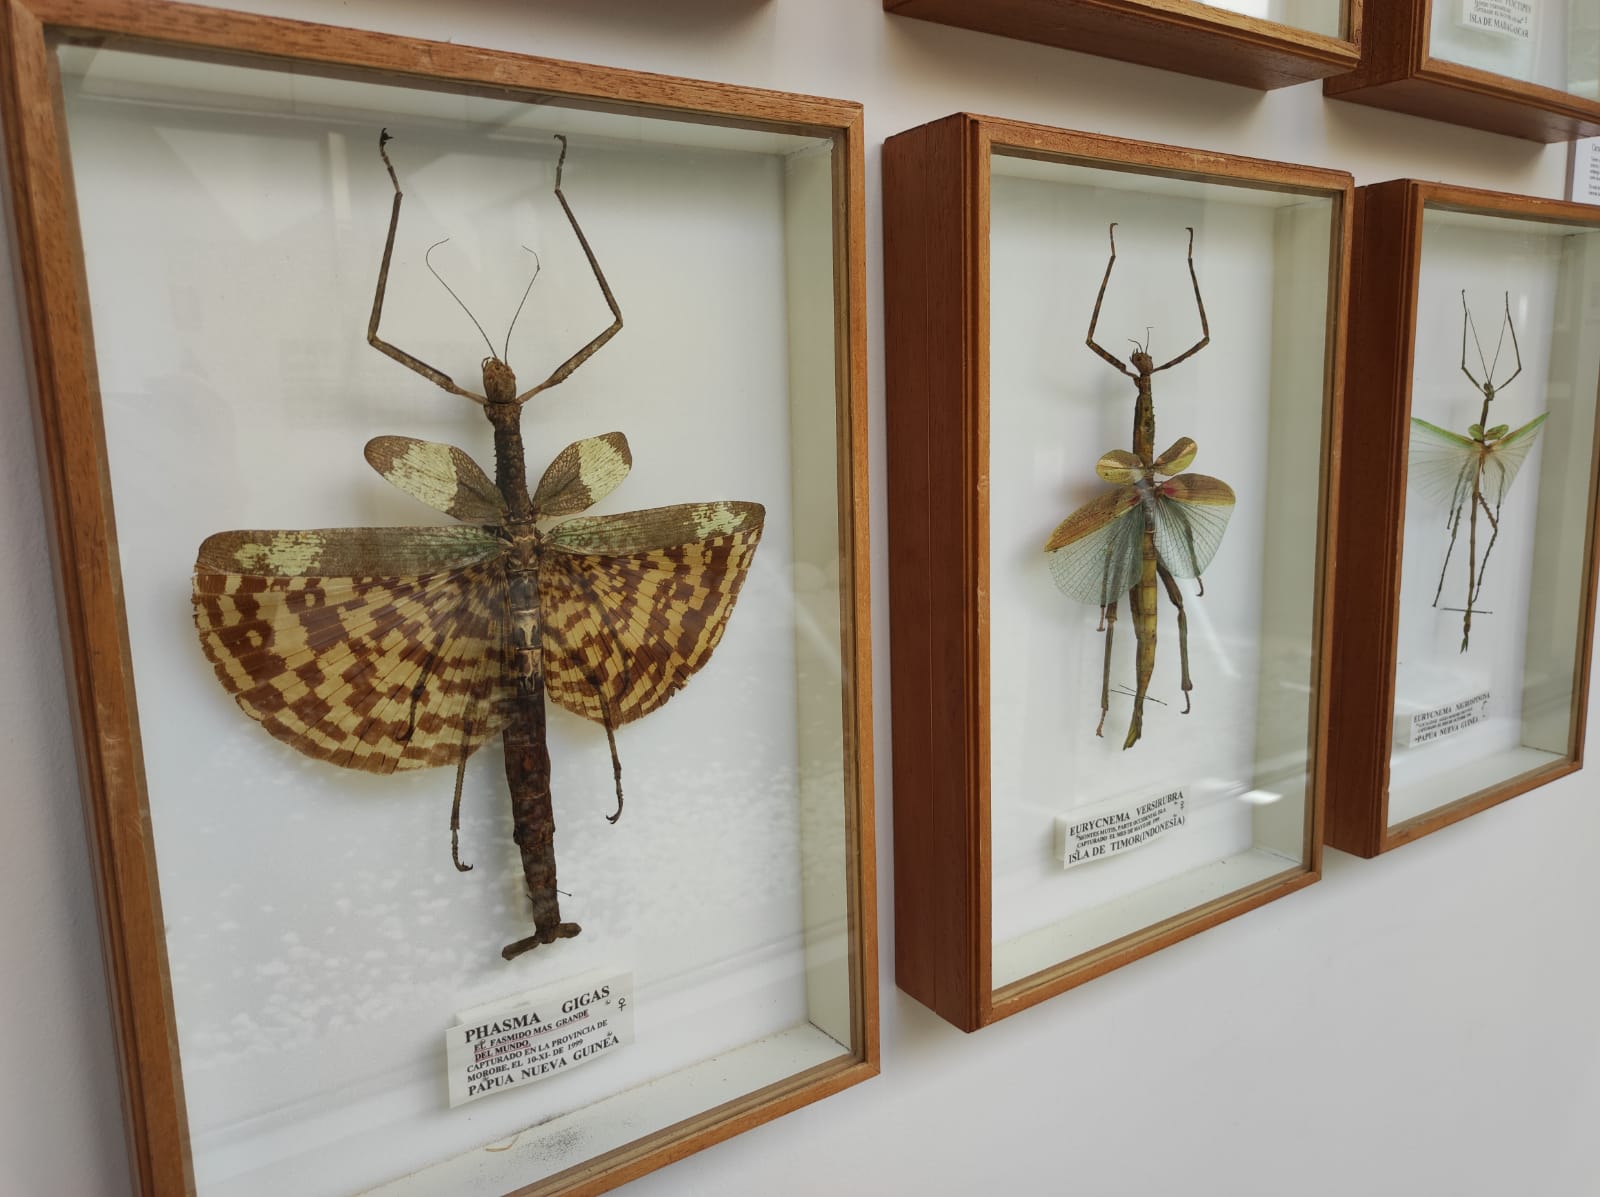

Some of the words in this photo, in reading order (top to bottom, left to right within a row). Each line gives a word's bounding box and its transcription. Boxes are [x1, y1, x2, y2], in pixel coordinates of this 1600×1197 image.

[1469, 12, 1482, 24] ISLA
[1070, 812, 1130, 836] EURYCNEMA
[1136, 791, 1183, 816] VERSIRUBRA
[1068, 849, 1090, 864] ISLA
[1092, 844, 1106, 857] DE
[465, 1012, 541, 1043] PHASMA
[561, 985, 611, 1014] GIGAS
[473, 1042, 487, 1053] EL
[490, 1029, 532, 1047] FASMIDO
[533, 1023, 553, 1036] MAS
[555, 1009, 589, 1028] GRANDE
[466, 1051, 523, 1073] CAPTURADO
[524, 1045, 537, 1056] EN
[538, 1042, 550, 1052] LA
[551, 1025, 596, 1048] PROVINCIA
[597, 1019, 608, 1030] DE
[467, 1063, 510, 1083] MOROBE,
[511, 1059, 523, 1069] EL
[552, 1046, 565, 1057] DE
[566, 1038, 584, 1051] 1999
[468, 1073, 514, 1096] PAPUA
[521, 1056, 567, 1080] NUEVA
[572, 1035, 620, 1062] GUINEA
[474, 1050, 494, 1062] DEL
